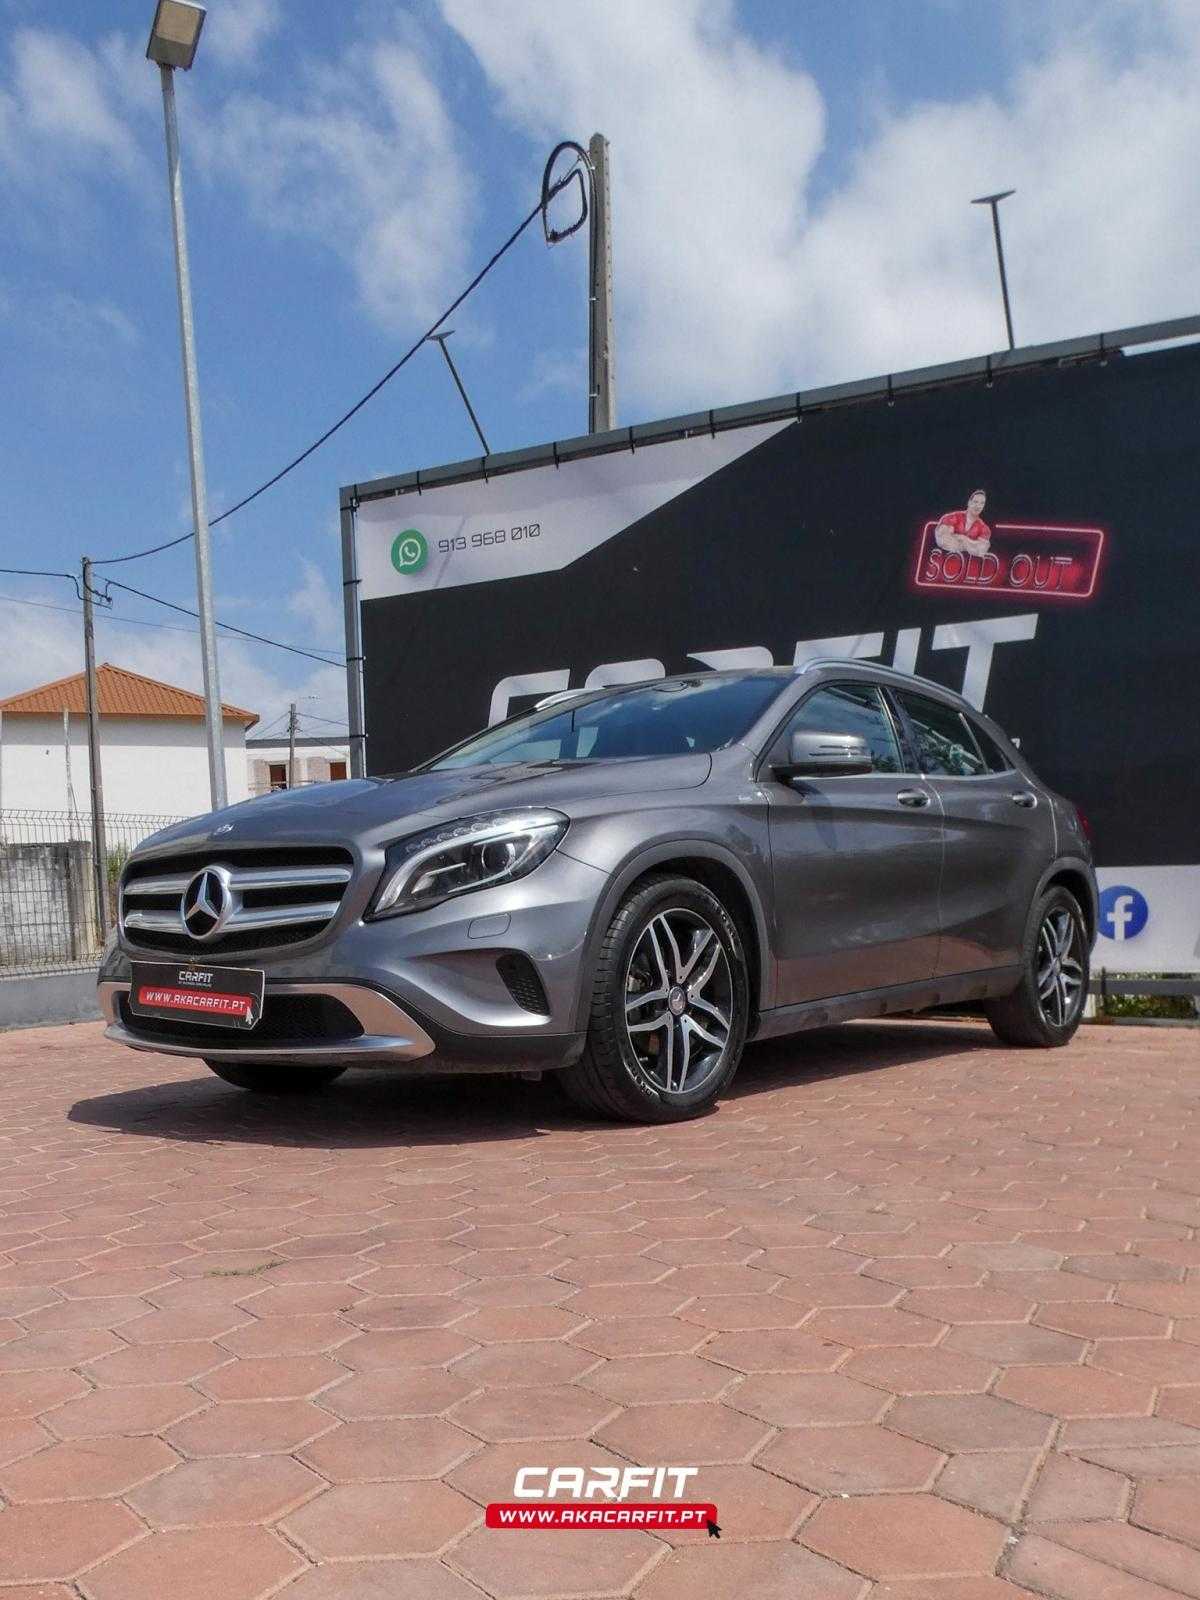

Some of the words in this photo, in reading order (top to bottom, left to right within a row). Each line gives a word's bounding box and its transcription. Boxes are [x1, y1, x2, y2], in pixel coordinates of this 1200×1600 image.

[438, 536, 467, 553] 913
[471, 529, 506, 548] 968
[511, 523, 541, 541] 010
[925, 548, 1000, 585] SOLD
[1008, 553, 1073, 590] OUT
[178, 970, 214, 983] CARFIT
[146, 991, 246, 1011] WWW.AKACARFIT.PT
